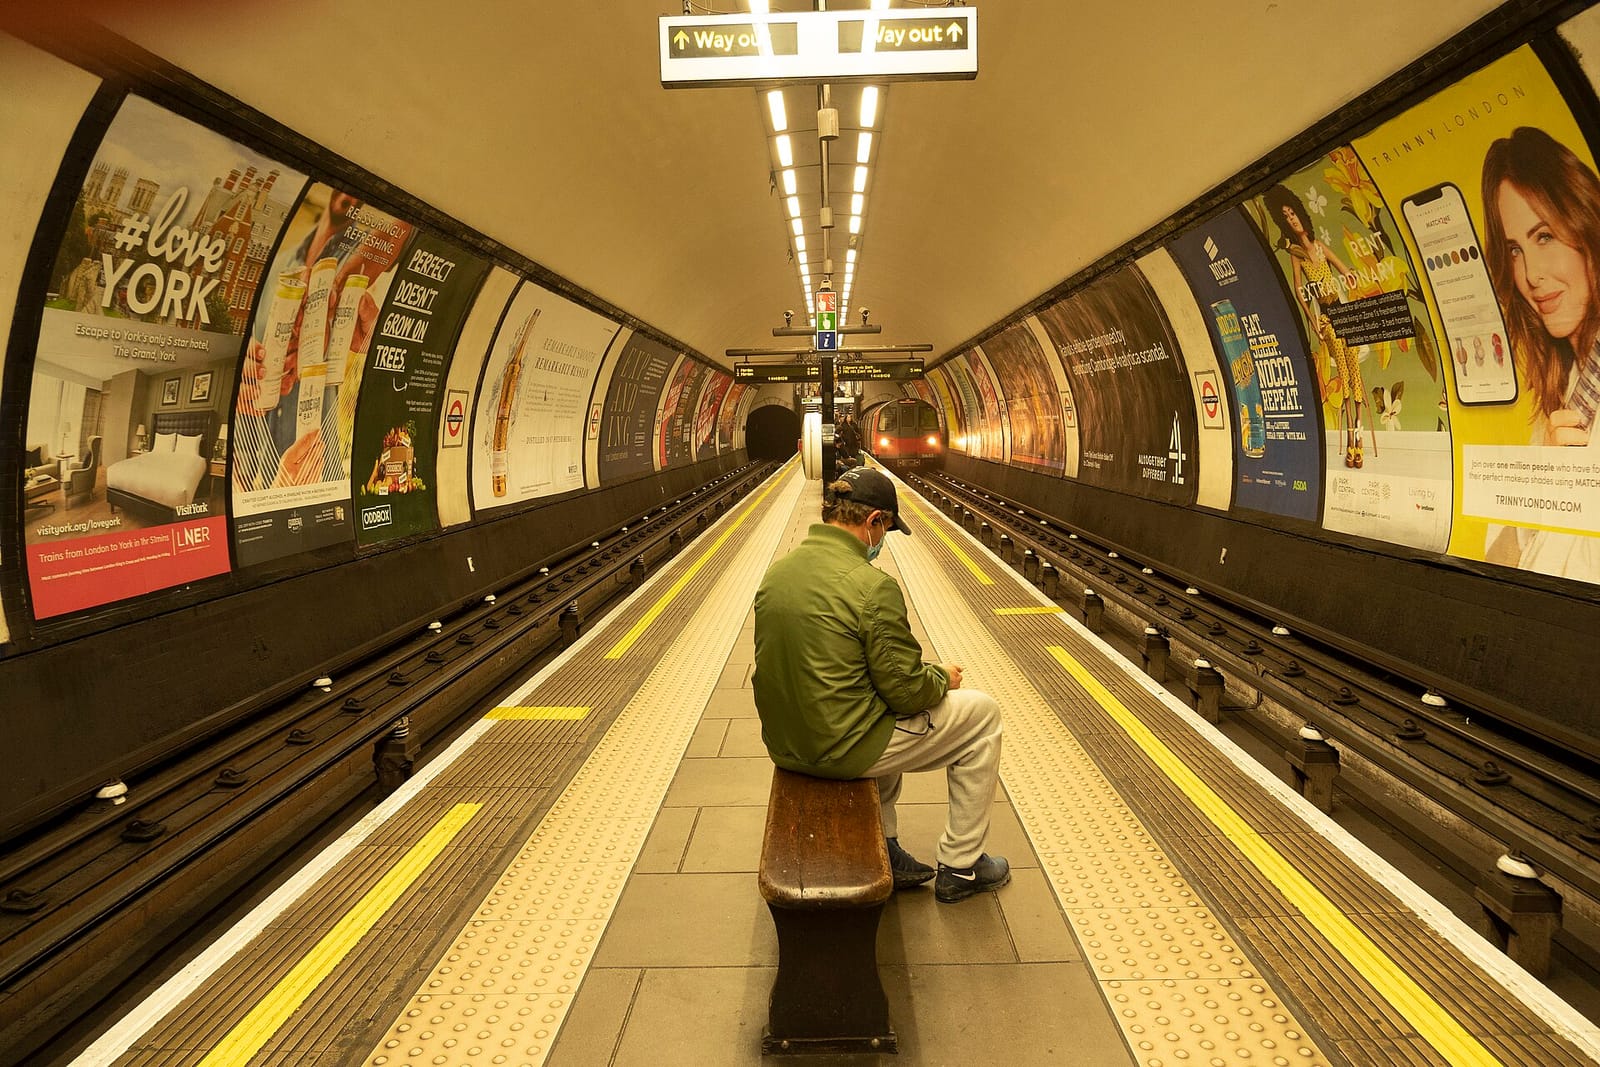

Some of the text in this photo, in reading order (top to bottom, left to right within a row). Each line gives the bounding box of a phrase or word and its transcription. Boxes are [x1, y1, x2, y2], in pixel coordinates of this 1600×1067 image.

[693, 30, 762, 52] Way ou
[909, 25, 943, 43] out
[1371, 85, 1526, 167] TRINNY LONDON
[113, 186, 226, 274] #love
[345, 205, 407, 240] REASSURINGLY
[343, 226, 396, 256] REFRESHING.
[1350, 231, 1386, 258] RENT
[408, 248, 456, 281] PERFECT
[1208, 256, 1236, 281] NOCCO
[101, 253, 221, 325] YORK
[1298, 259, 1396, 302] EXTRAORDINARY
[394, 279, 438, 310] DOESN'T
[75, 323, 210, 352] Escape to York's only 5 star hotel,
[383, 312, 430, 341] GROW ON
[1241, 313, 1266, 337] EAT.
[113, 344, 177, 362] The Grand, York
[375, 345, 407, 370] TREES.
[1114, 349, 1141, 370] Analytica
[1140, 341, 1169, 364] scandal.
[1255, 356, 1298, 389] NOCCO.
[1261, 387, 1302, 411] REPEAT.
[1143, 467, 1166, 482] DIFFERENT
[1496, 462, 1509, 470] one
[1509, 461, 1531, 471] million
[1531, 462, 1555, 473] people
[1555, 463, 1571, 472] who
[1572, 463, 1591, 473] have
[1292, 480, 1308, 491] ASDA
[1482, 473, 1504, 483] perfect
[1504, 474, 1530, 484] makeup
[1530, 475, 1554, 485] shades
[1554, 477, 1574, 489] using
[1408, 487, 1436, 501] Living by
[1495, 495, 1582, 513] TRINNYLONDON.COM
[37, 517, 121, 536] visityork.org/loveyork
[364, 508, 391, 526] ODDBOX
[177, 526, 211, 548] LNER
[39, 551, 64, 563] Trains
[65, 548, 83, 560] from
[84, 543, 110, 558] London
[110, 542, 118, 552] to
[119, 540, 134, 550] York
[134, 538, 140, 547] in
